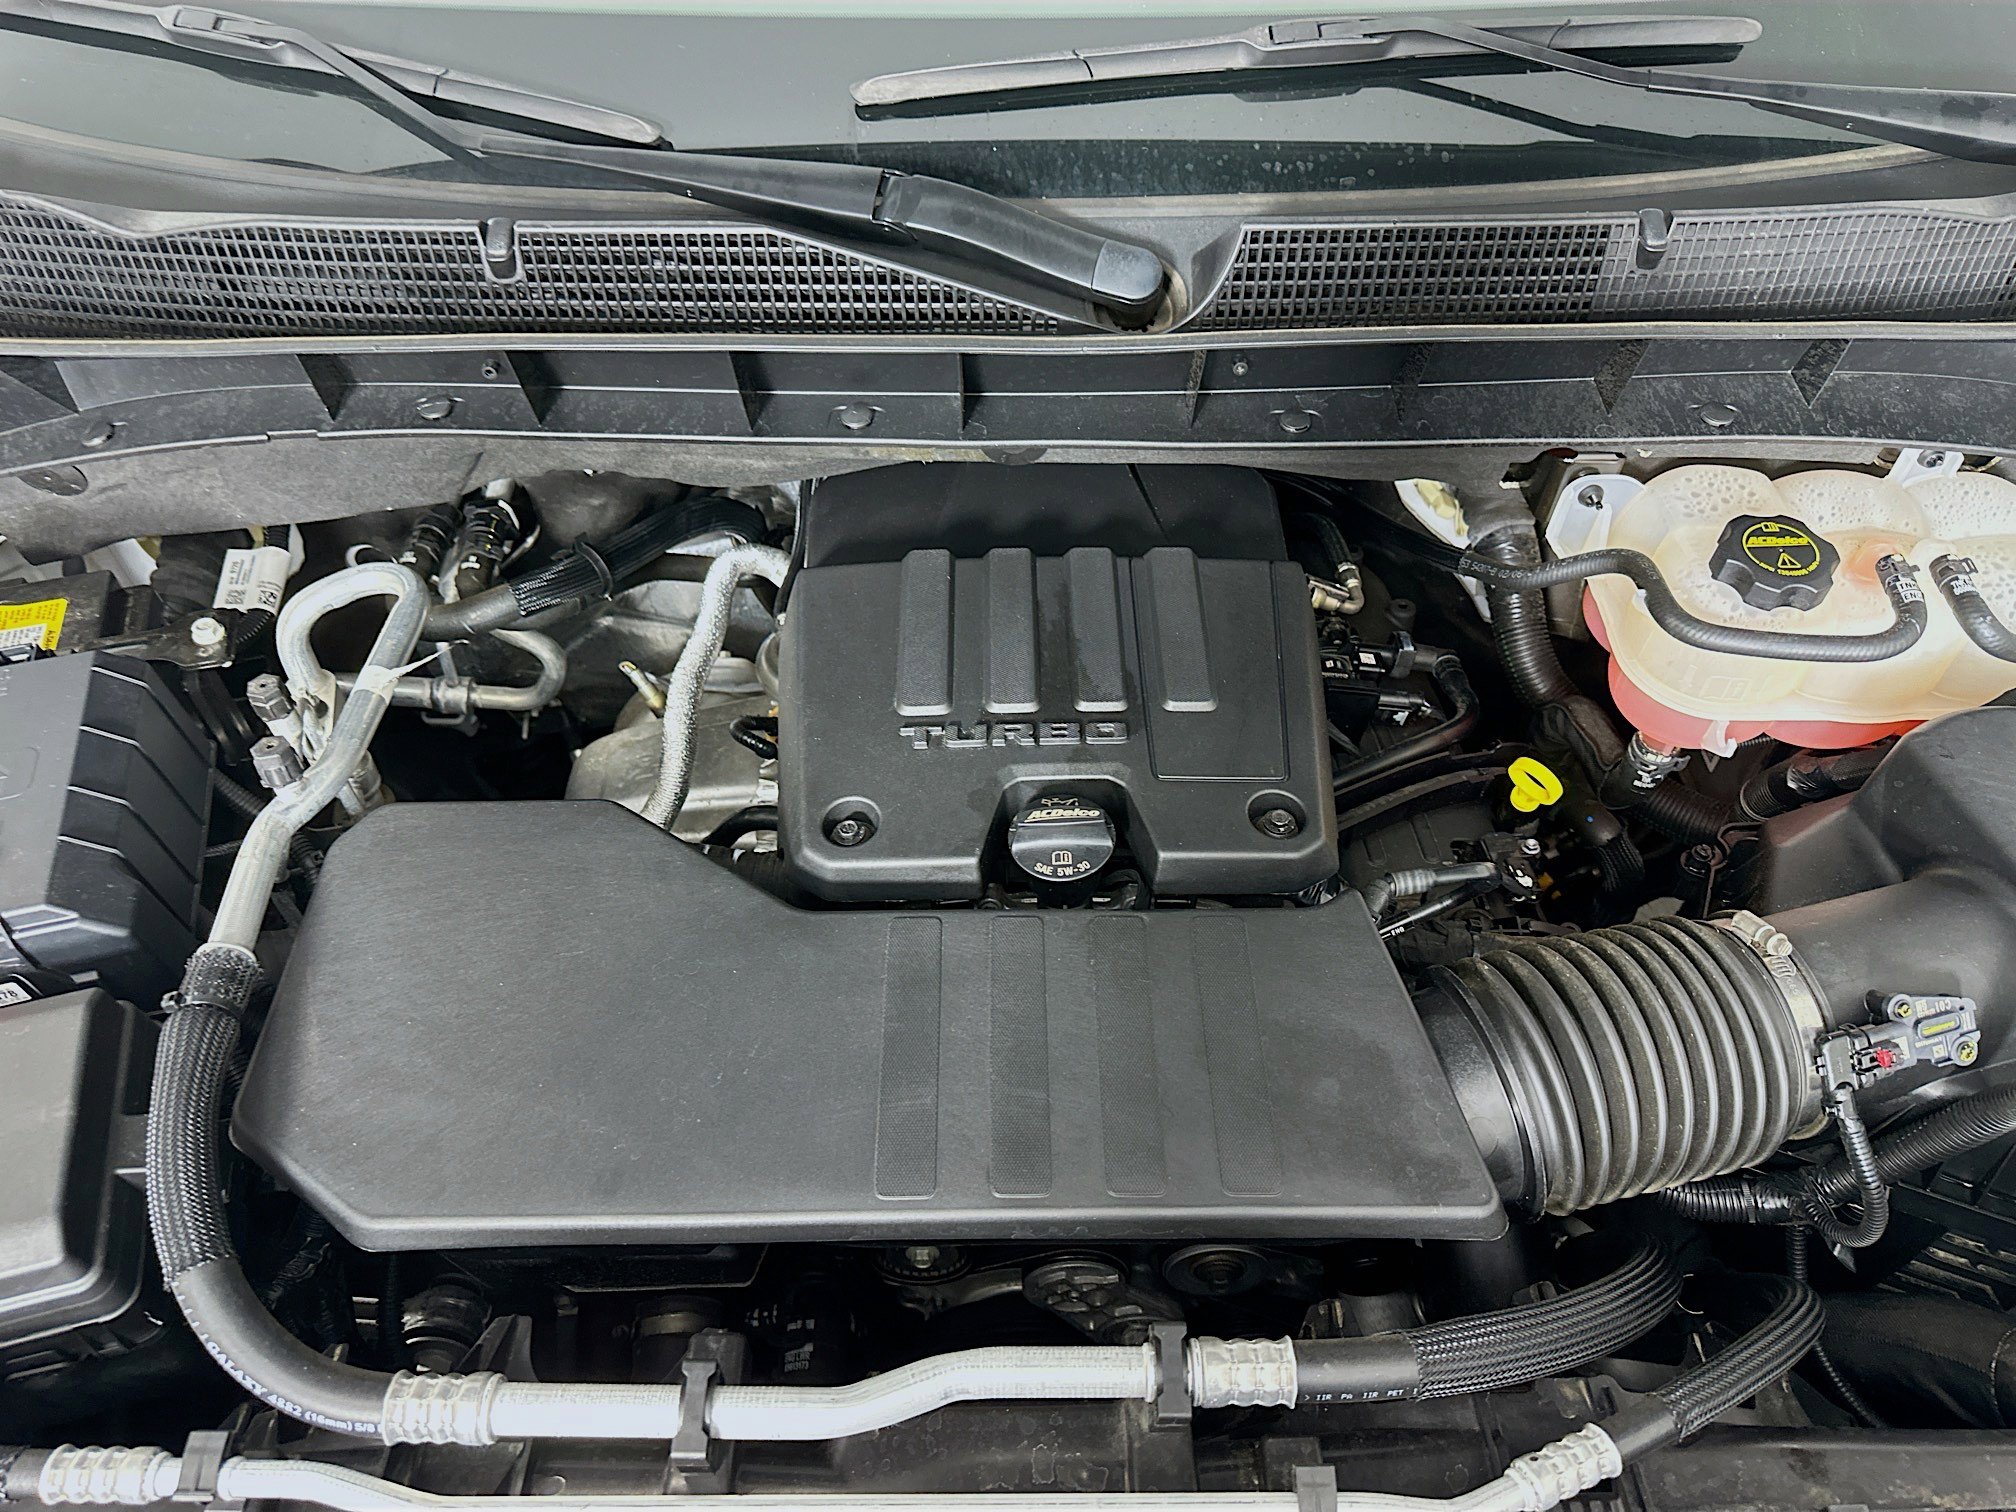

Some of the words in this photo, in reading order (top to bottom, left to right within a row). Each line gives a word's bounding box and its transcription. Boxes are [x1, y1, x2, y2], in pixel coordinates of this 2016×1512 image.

[899, 721, 1128, 749] TURBO
[1026, 808, 1101, 821] ACDelco
[1034, 862, 1054, 876] SAE
[1057, 860, 1091, 876] 5W-30
[205, 1341, 268, 1396] GALAXY
[304, 1410, 353, 1432] (16mm)
[354, 1422, 376, 1433] 5/8
[1387, 1389, 1404, 1397] PET
